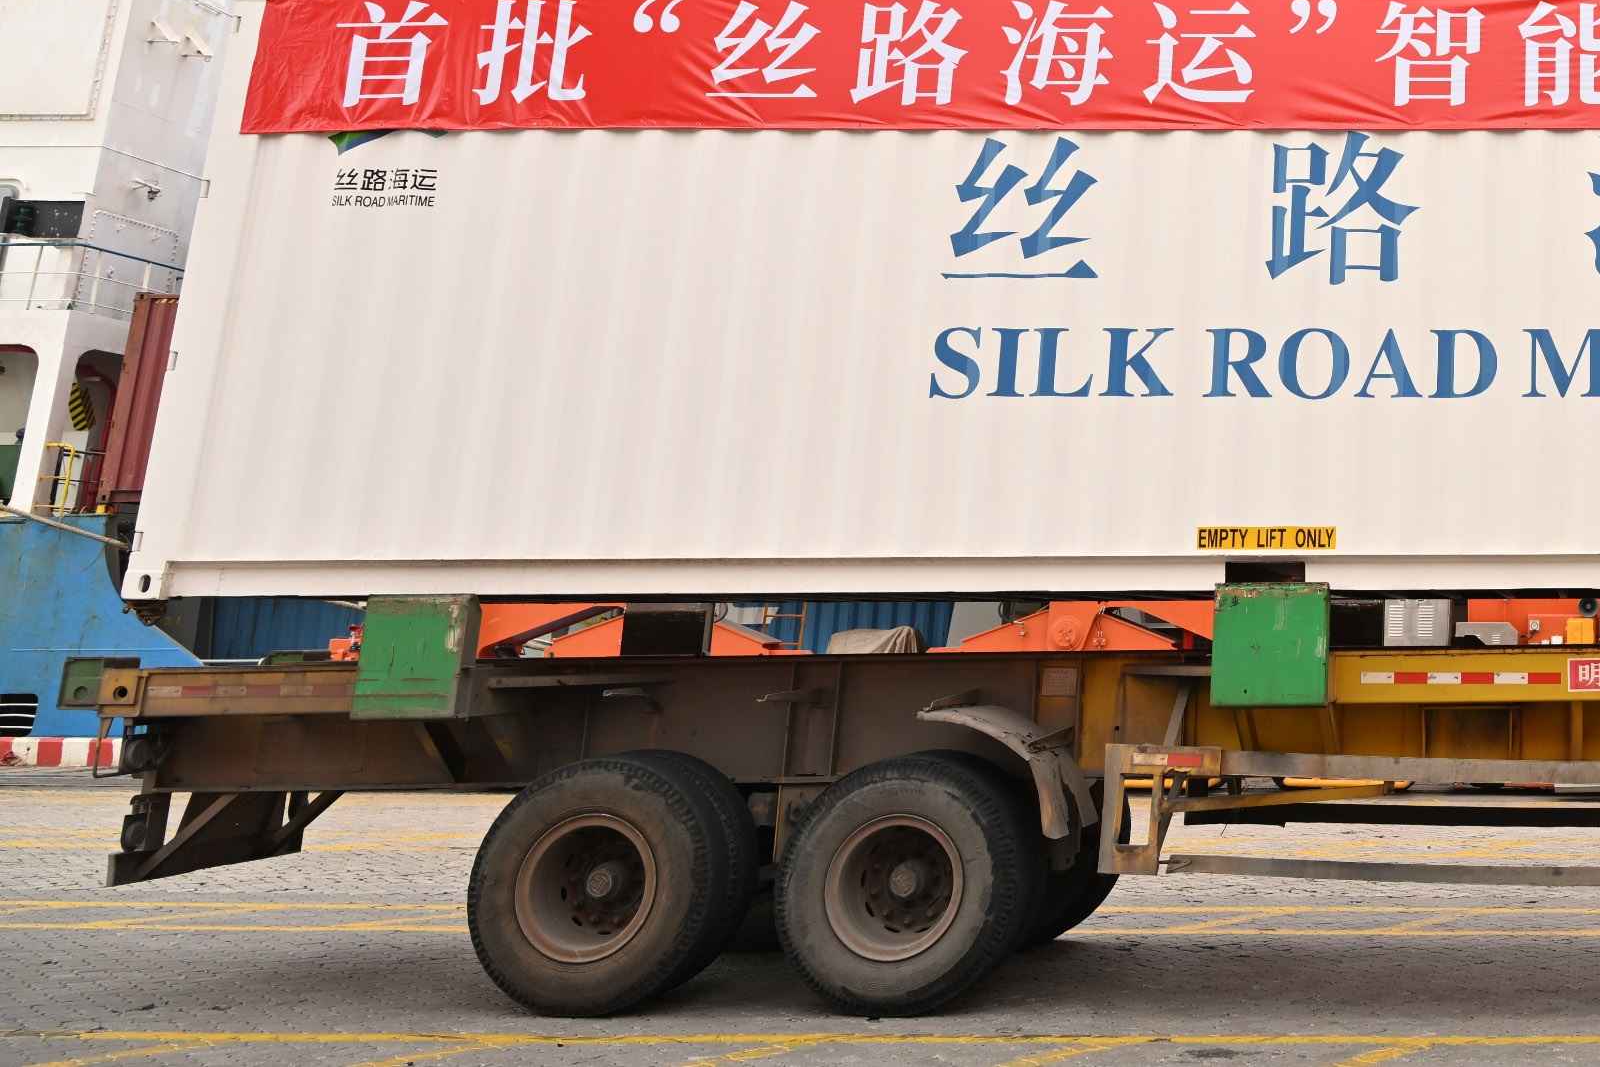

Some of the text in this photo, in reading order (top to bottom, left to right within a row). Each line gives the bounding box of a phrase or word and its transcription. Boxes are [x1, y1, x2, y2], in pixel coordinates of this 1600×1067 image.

[334, 168, 438, 191] 丝路海运
[332, 194, 436, 207] SILK ROAD MARITIME
[930, 327, 1173, 399] SILK
[1203, 327, 1498, 399] ROAD
[1198, 528, 1334, 548] EMPTY LIFT ONLY
